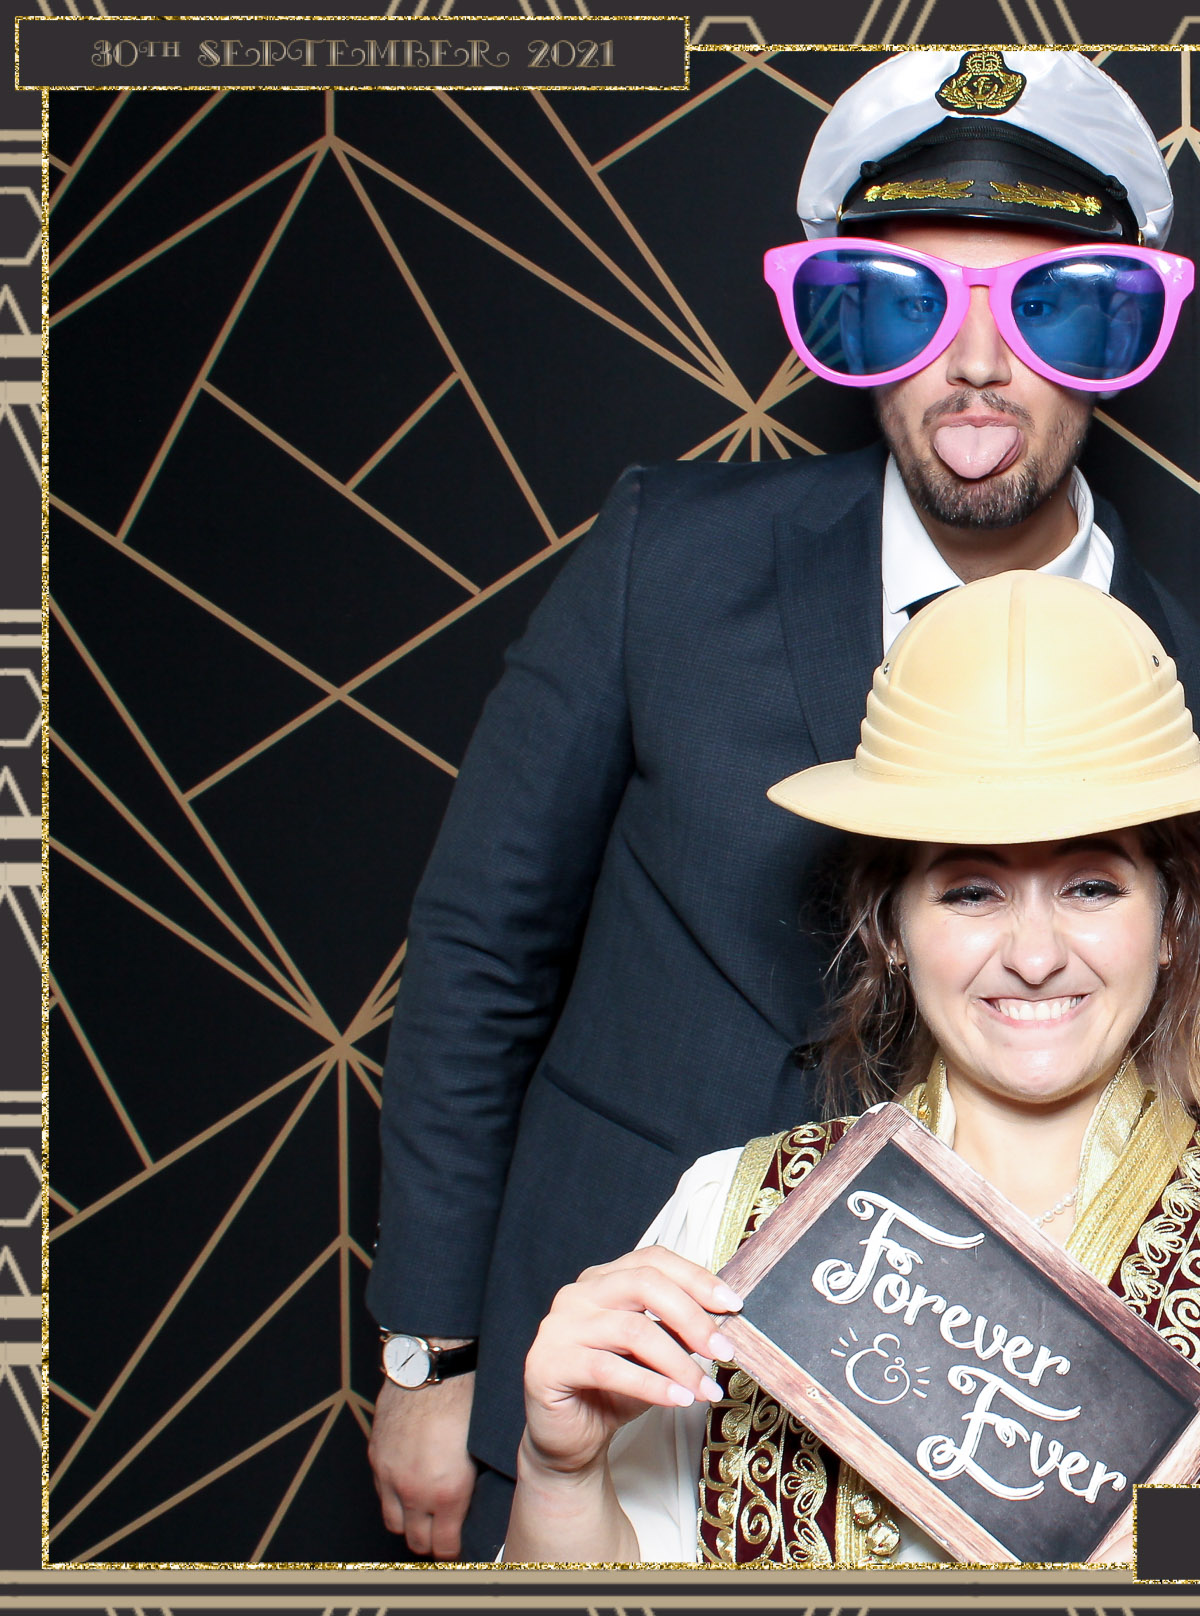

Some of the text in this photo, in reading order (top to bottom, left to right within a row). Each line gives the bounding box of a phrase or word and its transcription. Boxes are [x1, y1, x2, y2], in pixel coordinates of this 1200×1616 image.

[811, 1190, 1071, 1386] Forever
[845, 1333, 911, 1405] &
[916, 1364, 1127, 1503] Ever
